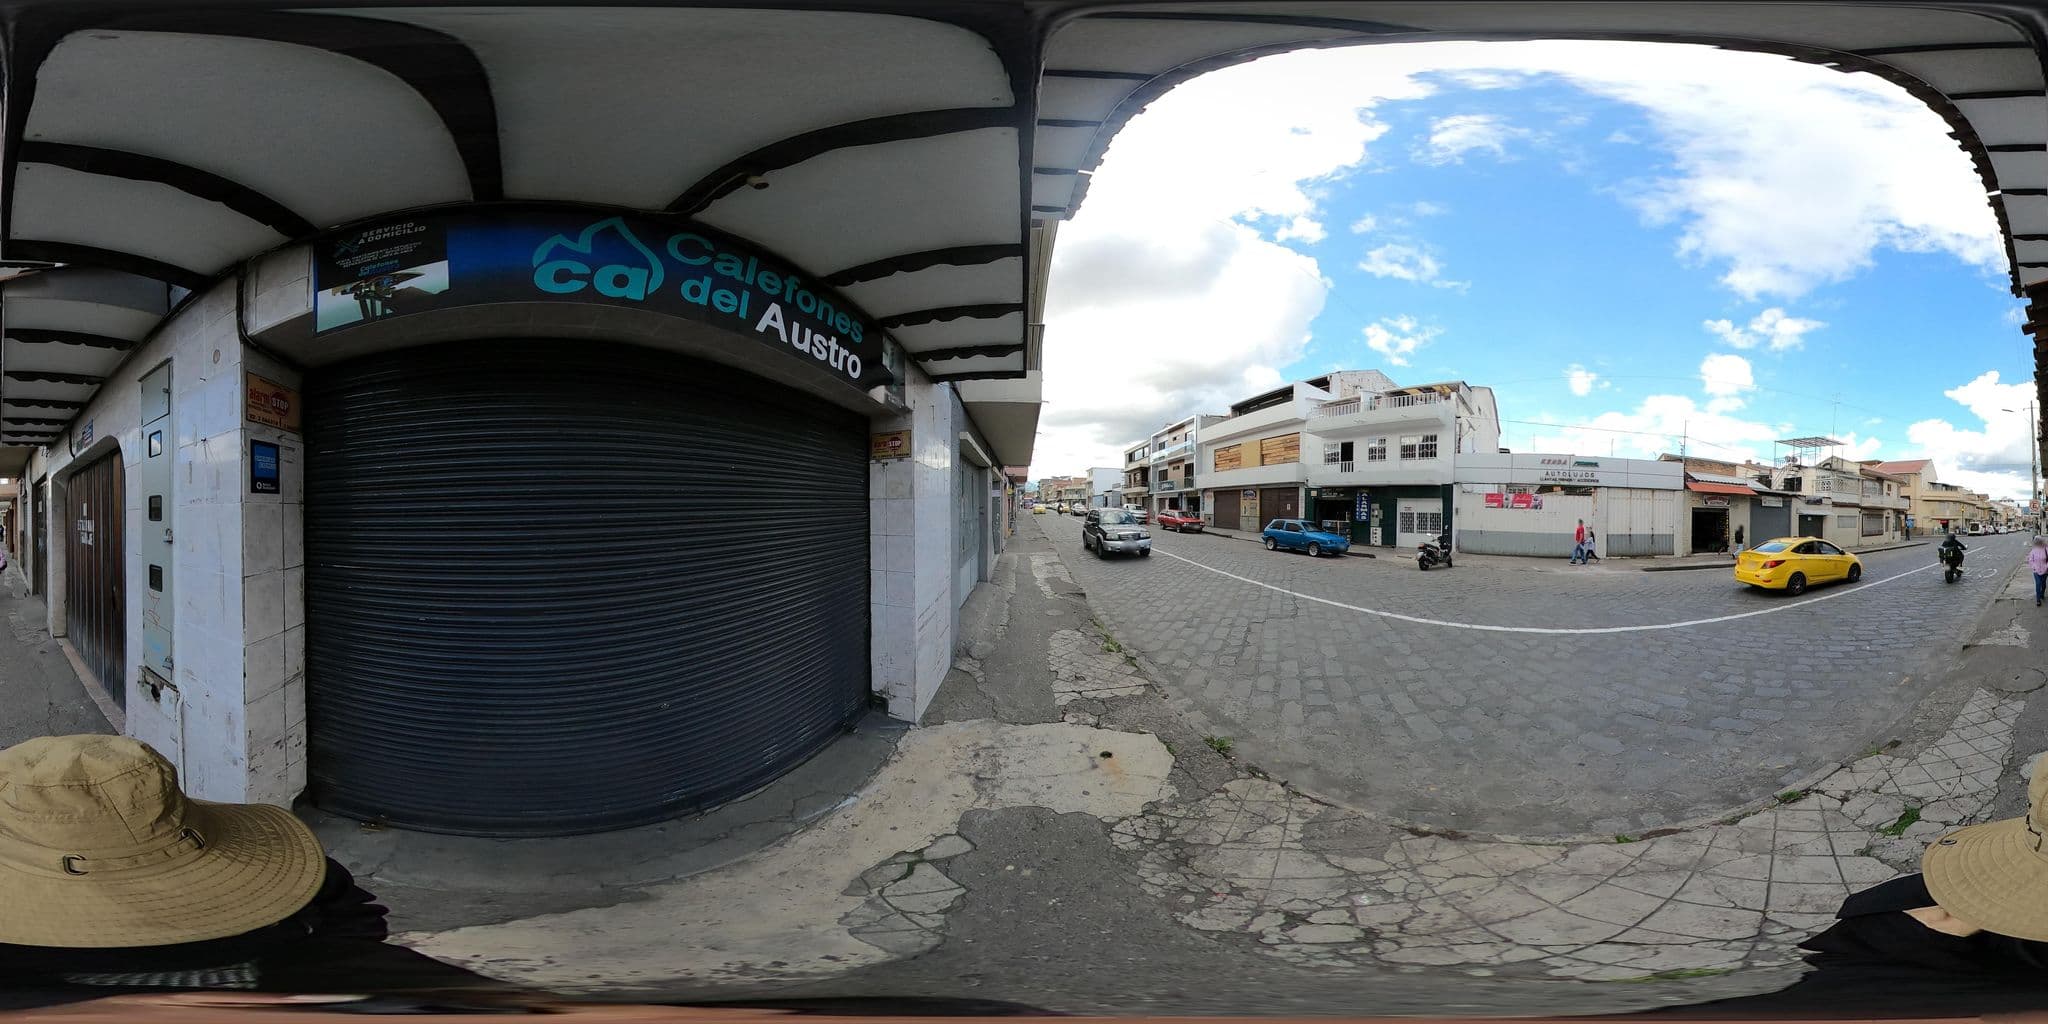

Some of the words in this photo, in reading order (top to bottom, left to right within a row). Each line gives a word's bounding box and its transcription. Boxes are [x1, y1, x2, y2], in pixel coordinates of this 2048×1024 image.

[362, 222, 414, 238] SERVICIO
[533, 260, 649, 302] ca
[667, 233, 864, 344] Calefones
[681, 276, 750, 320] del
[755, 303, 862, 379] Austro
[271, 396, 288, 411] STOP
[1545, 470, 1595, 478] AUTOLUJOS
